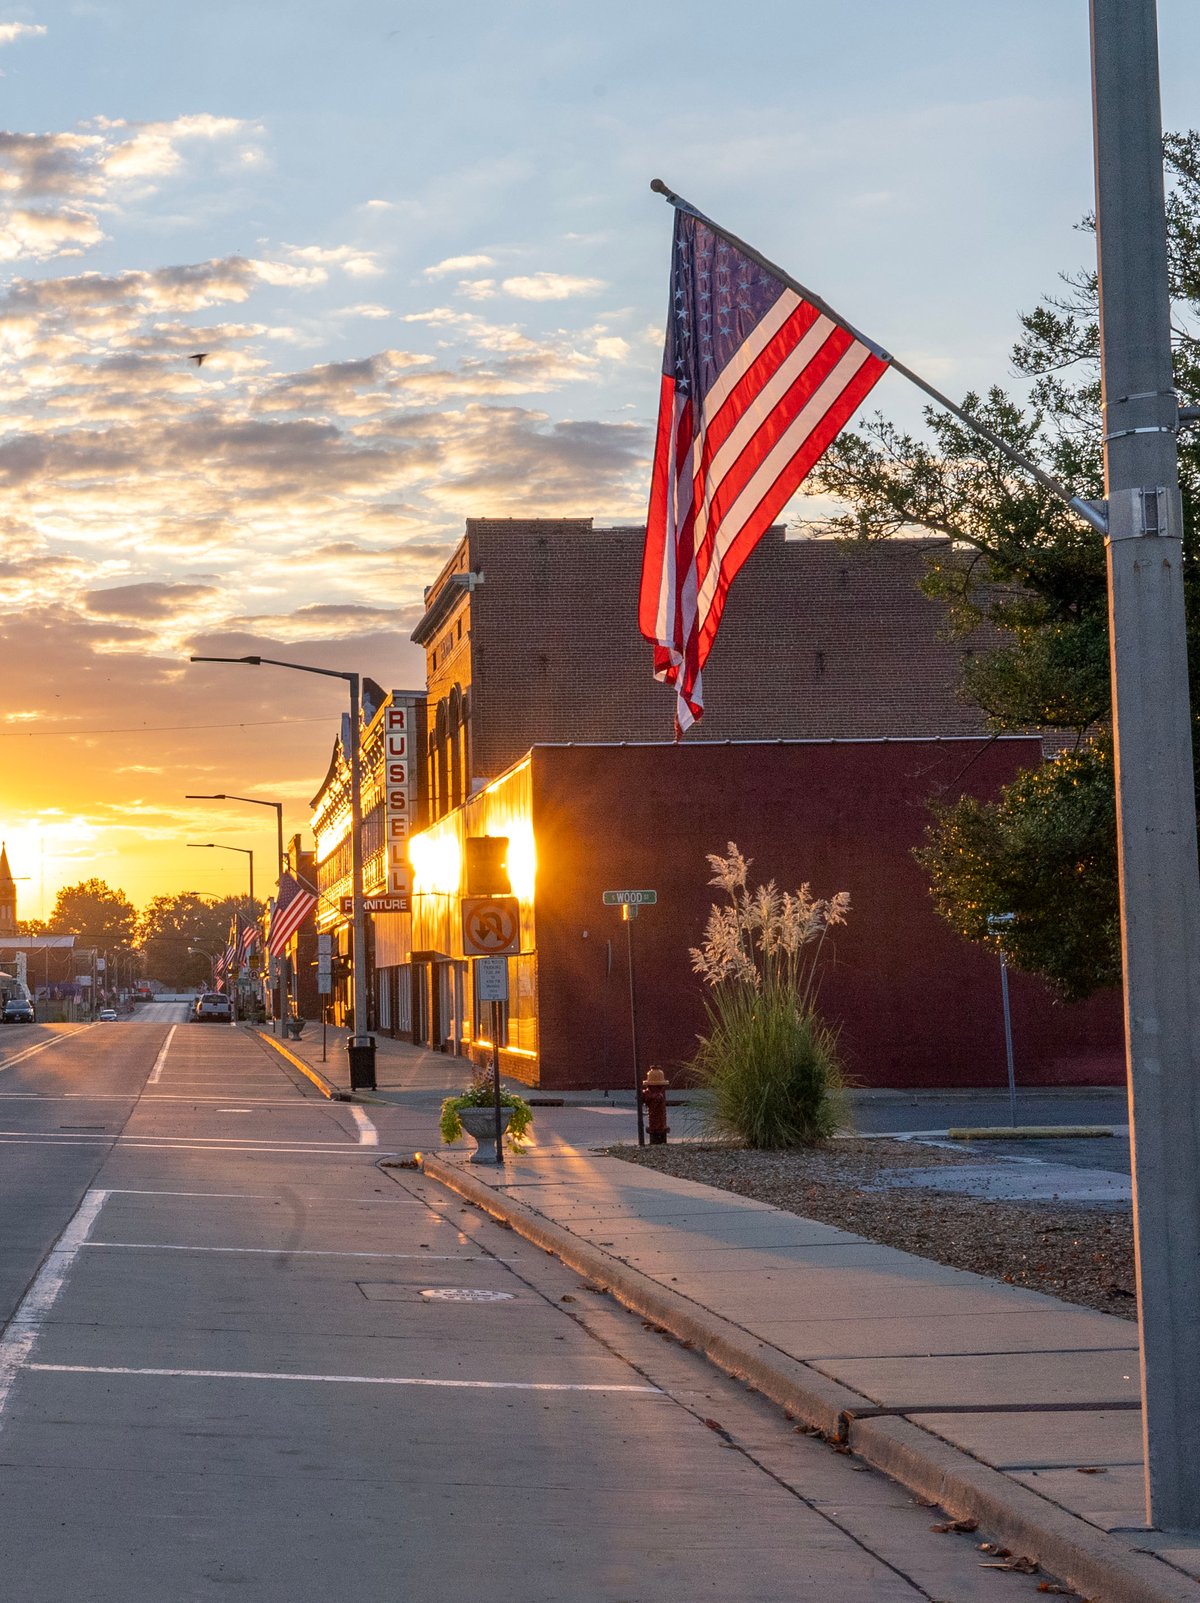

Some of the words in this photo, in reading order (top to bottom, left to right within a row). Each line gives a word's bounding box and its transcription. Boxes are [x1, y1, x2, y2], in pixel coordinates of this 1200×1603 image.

[388, 710, 406, 891] RUSSELL
[617, 893, 642, 902] WOOD
[345, 899, 407, 910] FNITURE
